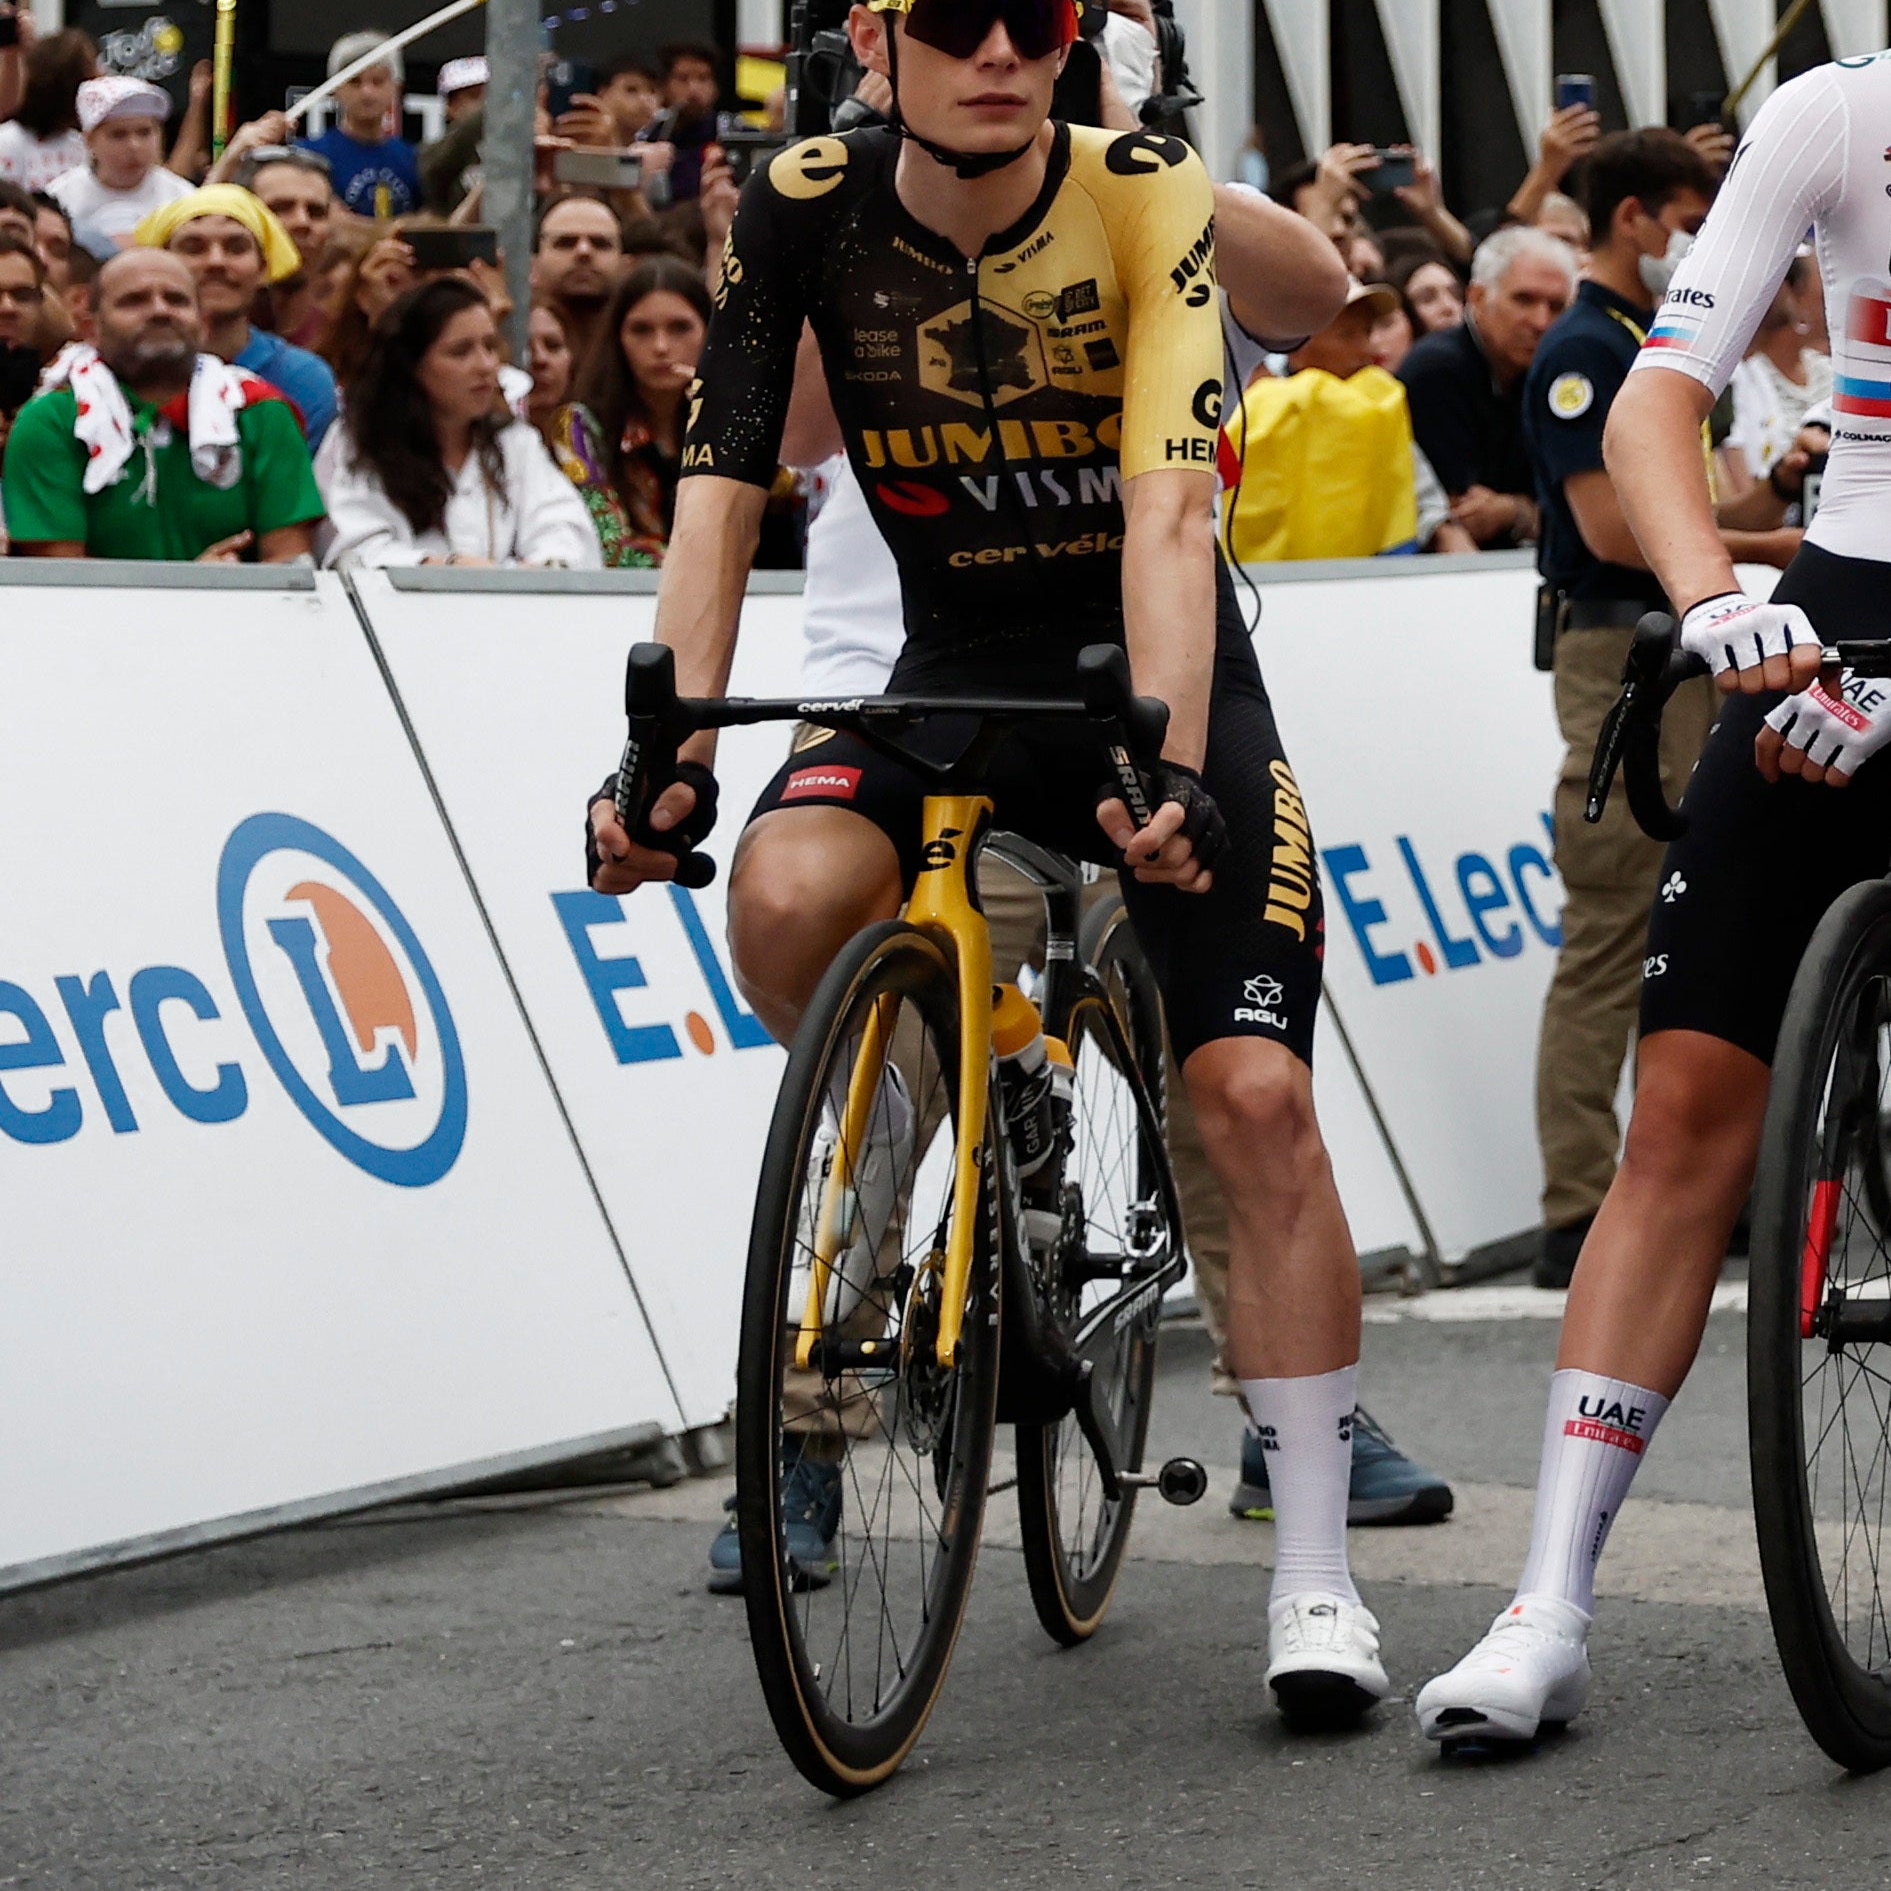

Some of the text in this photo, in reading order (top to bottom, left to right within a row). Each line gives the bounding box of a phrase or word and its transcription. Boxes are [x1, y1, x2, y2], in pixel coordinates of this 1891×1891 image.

[1016, 231, 1056, 263] VISMA
[854, 327, 898, 342] lease
[866, 342, 901, 359] bike
[958, 465, 1123, 511] VISM
[1812, 686, 1861, 728] Emirates
[790, 775, 851, 790] HEMA
[1263, 759, 1312, 943] JUMBO
[1234, 1006, 1289, 1031] AGU
[1578, 1395, 1646, 1432] UAE
